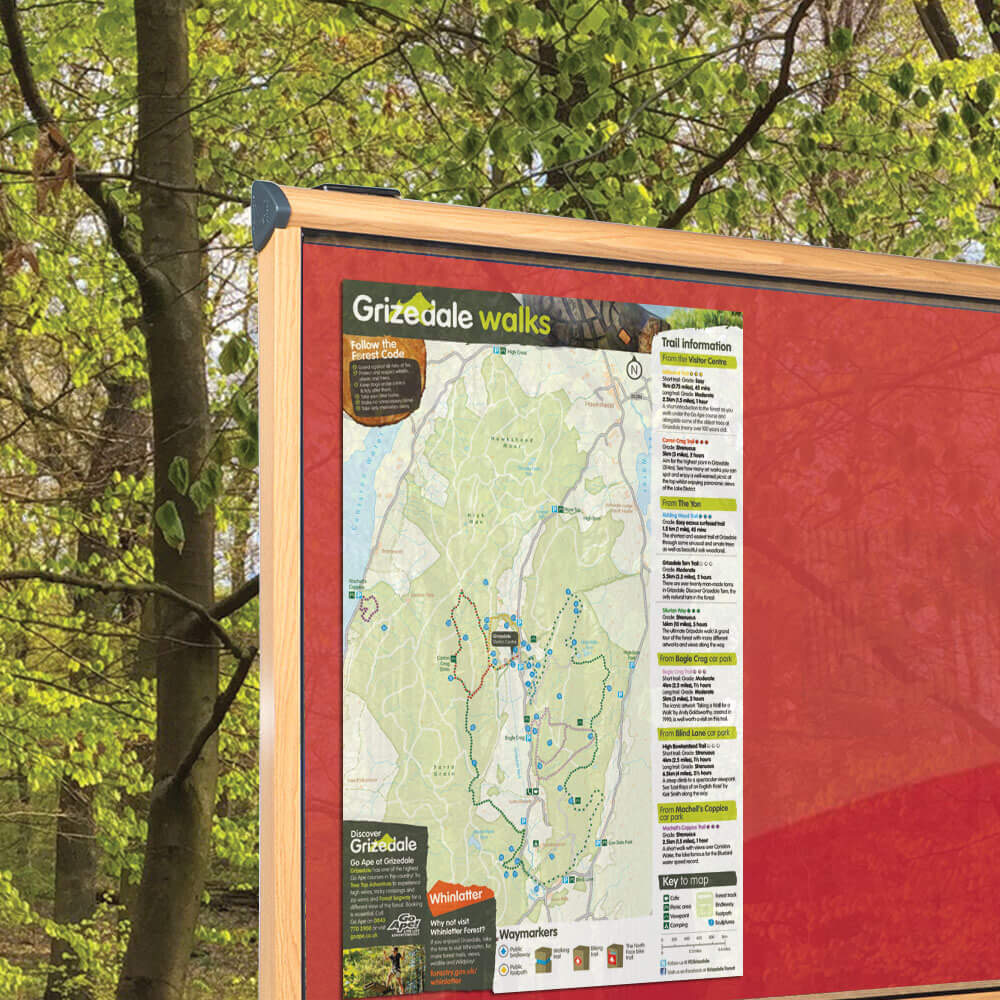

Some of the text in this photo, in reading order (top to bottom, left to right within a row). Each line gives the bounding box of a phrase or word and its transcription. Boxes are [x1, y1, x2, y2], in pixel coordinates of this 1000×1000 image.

[352, 294, 551, 335] Grizedale walks
[351, 338, 397, 350] Follow the
[662, 337, 732, 352] Trail information
[352, 348, 405, 360] Forest Code
[688, 356, 706, 364] Visitor
[707, 357, 727, 366] Centre
[631, 364, 638, 376] N
[678, 499, 689, 507] The
[659, 654, 674, 662] From
[675, 655, 692, 664] Bogle
[693, 654, 708, 664] Crag
[719, 655, 732, 663] park
[675, 729, 690, 737] Blind
[691, 729, 706, 737] Lane
[717, 729, 730, 737] park
[660, 803, 729, 814] From Machell's Coppice
[670, 814, 683, 822] park
[350, 829, 381, 838] Discover
[350, 836, 417, 853] Grizedale
[350, 858, 360, 866] Go
[361, 859, 374, 867] Ape
[384, 856, 415, 864] Grizedale
[662, 876, 709, 888] Key to map
[429, 890, 483, 904] Whinlatter
[398, 912, 416, 921] Go
[457, 918, 470, 926] visit
[430, 927, 462, 936] Whinlatter
[463, 926, 486, 934] Forest?
[499, 927, 558, 941] Waymarkers
